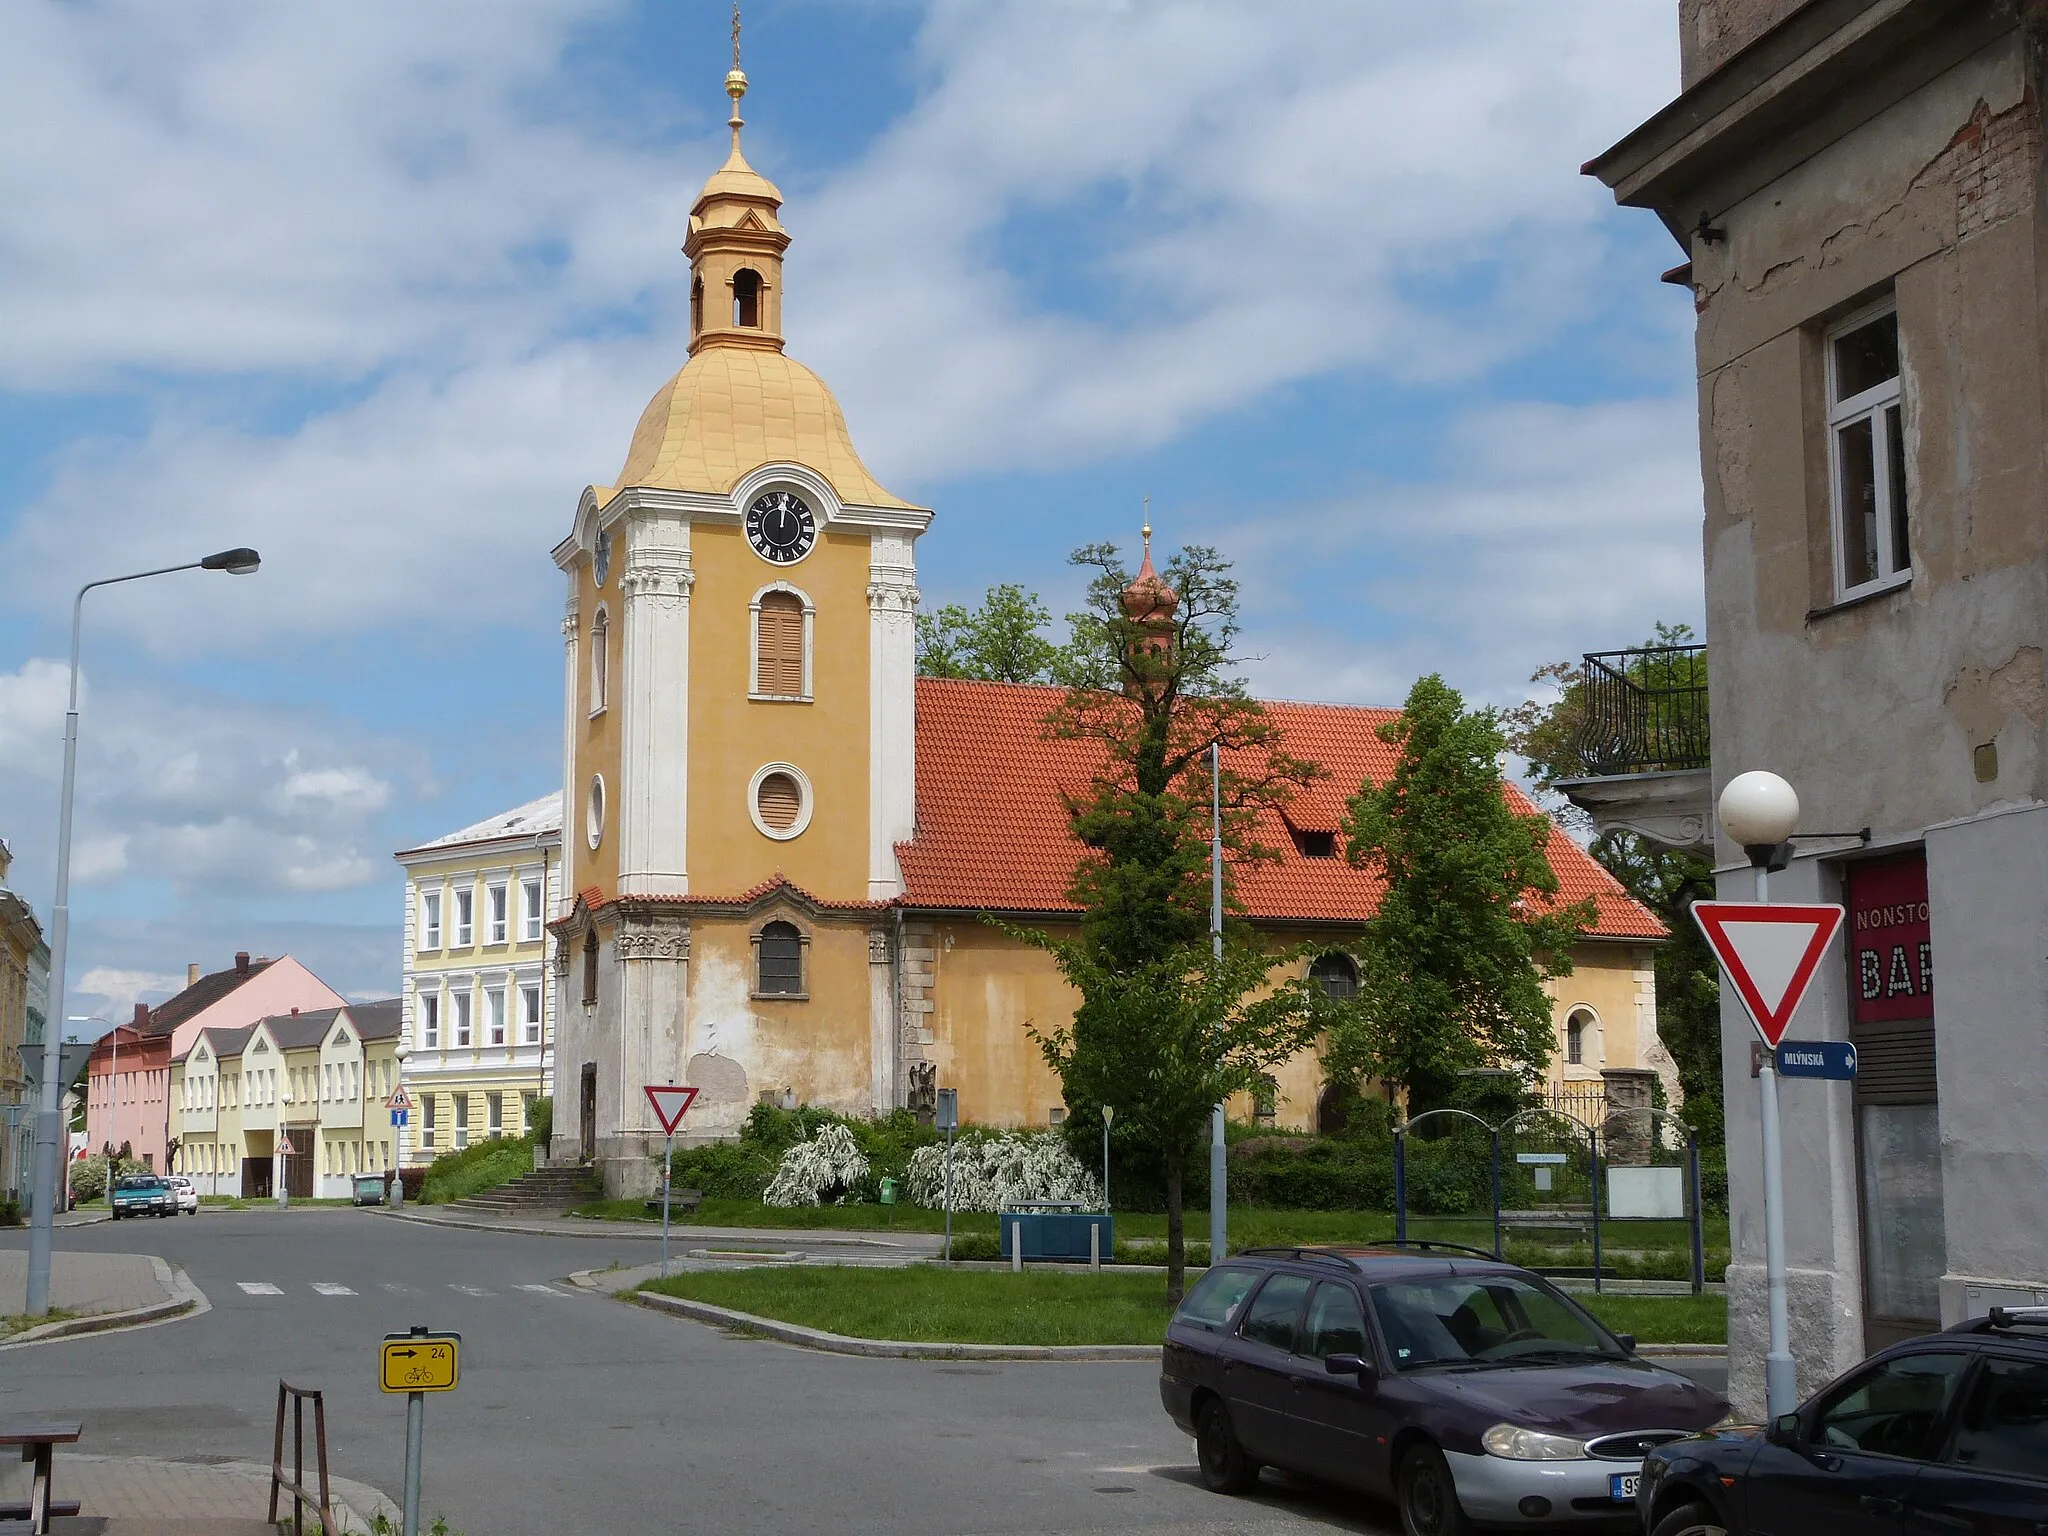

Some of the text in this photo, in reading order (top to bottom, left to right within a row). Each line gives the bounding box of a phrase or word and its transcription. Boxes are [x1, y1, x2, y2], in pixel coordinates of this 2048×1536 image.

[800, 511, 810, 519] II
[1784, 1051, 1824, 1066] MLÝNSKÁ
[432, 1348, 444, 1358] 24
